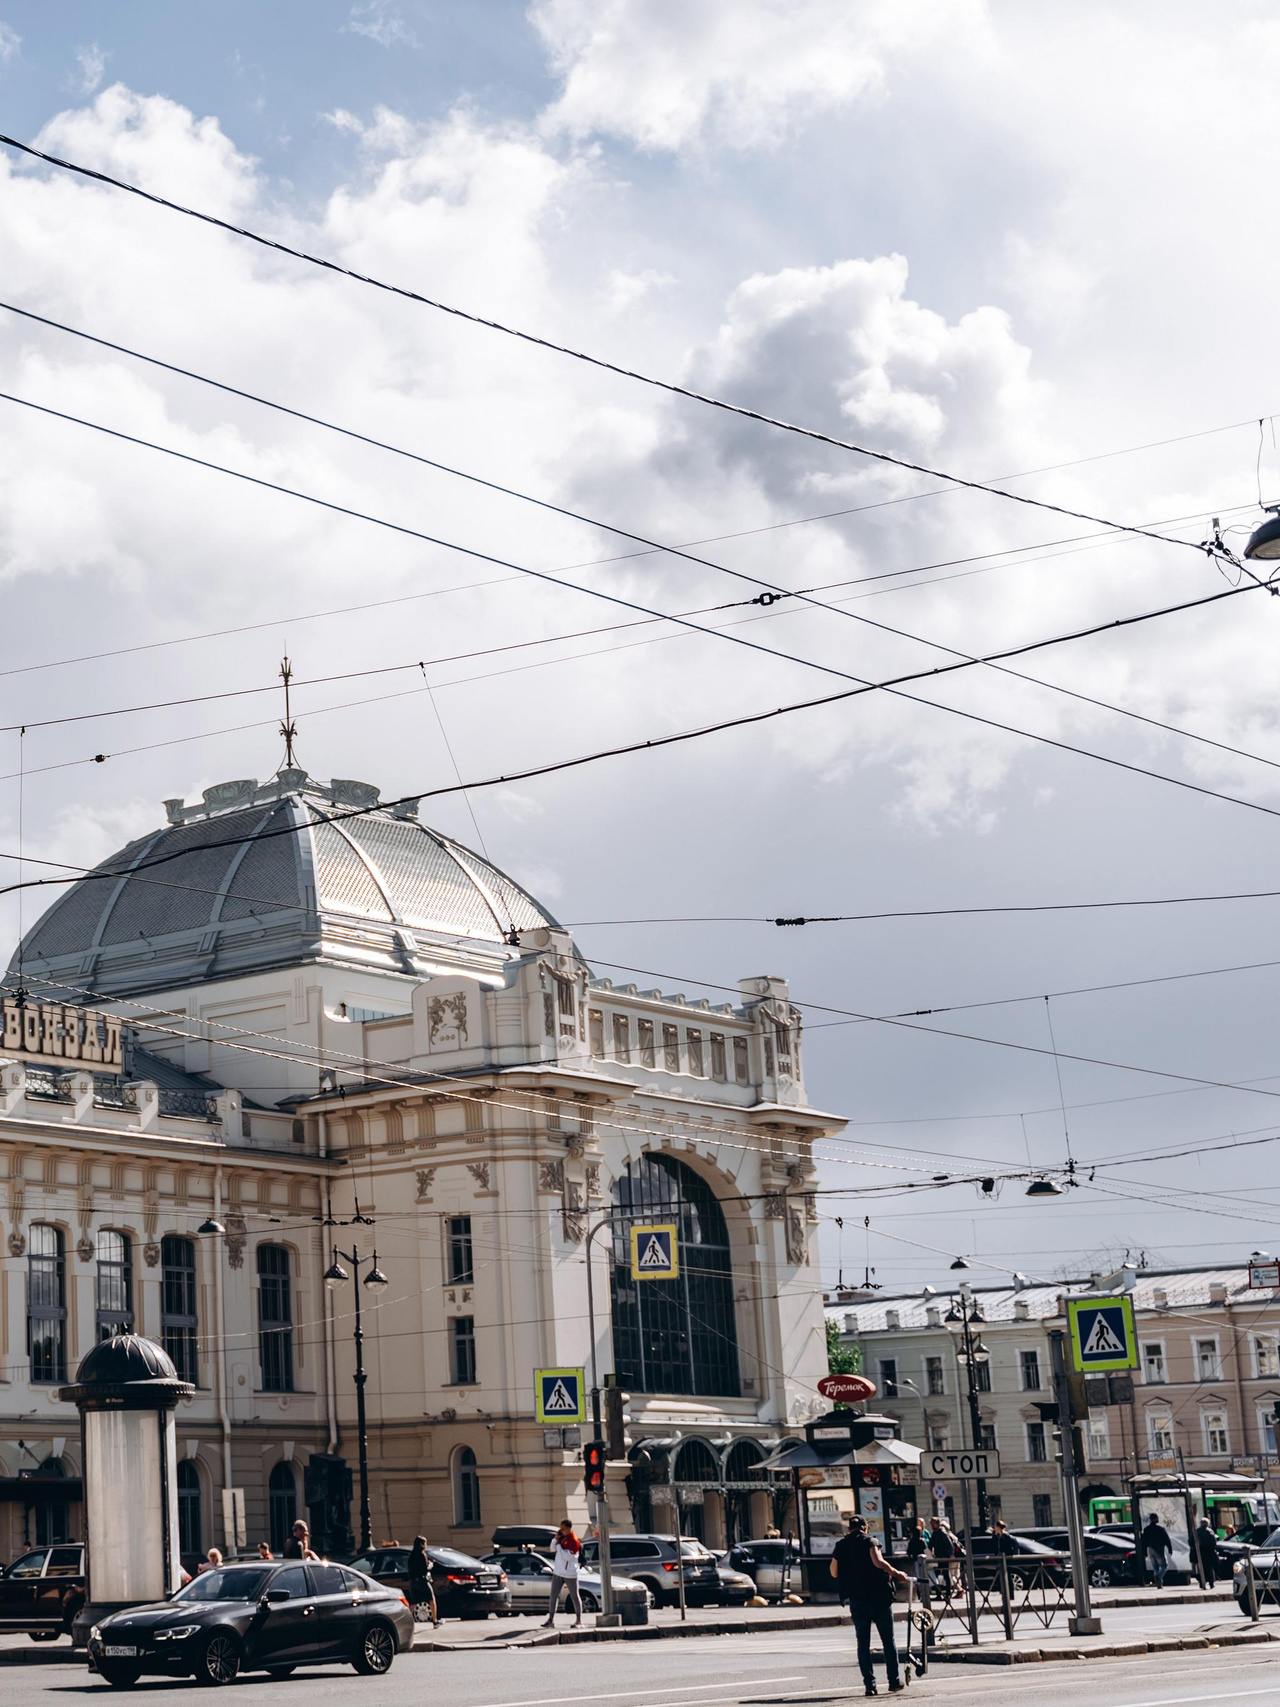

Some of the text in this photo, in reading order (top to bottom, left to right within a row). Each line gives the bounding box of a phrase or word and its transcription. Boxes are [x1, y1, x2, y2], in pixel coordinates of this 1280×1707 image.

[2, 996, 123, 1065] ВОКЗАЛ
[824, 1381, 865, 1397] Теремок
[820, 1429, 845, 1437] Теремок
[931, 1454, 989, 1475] СТОП
